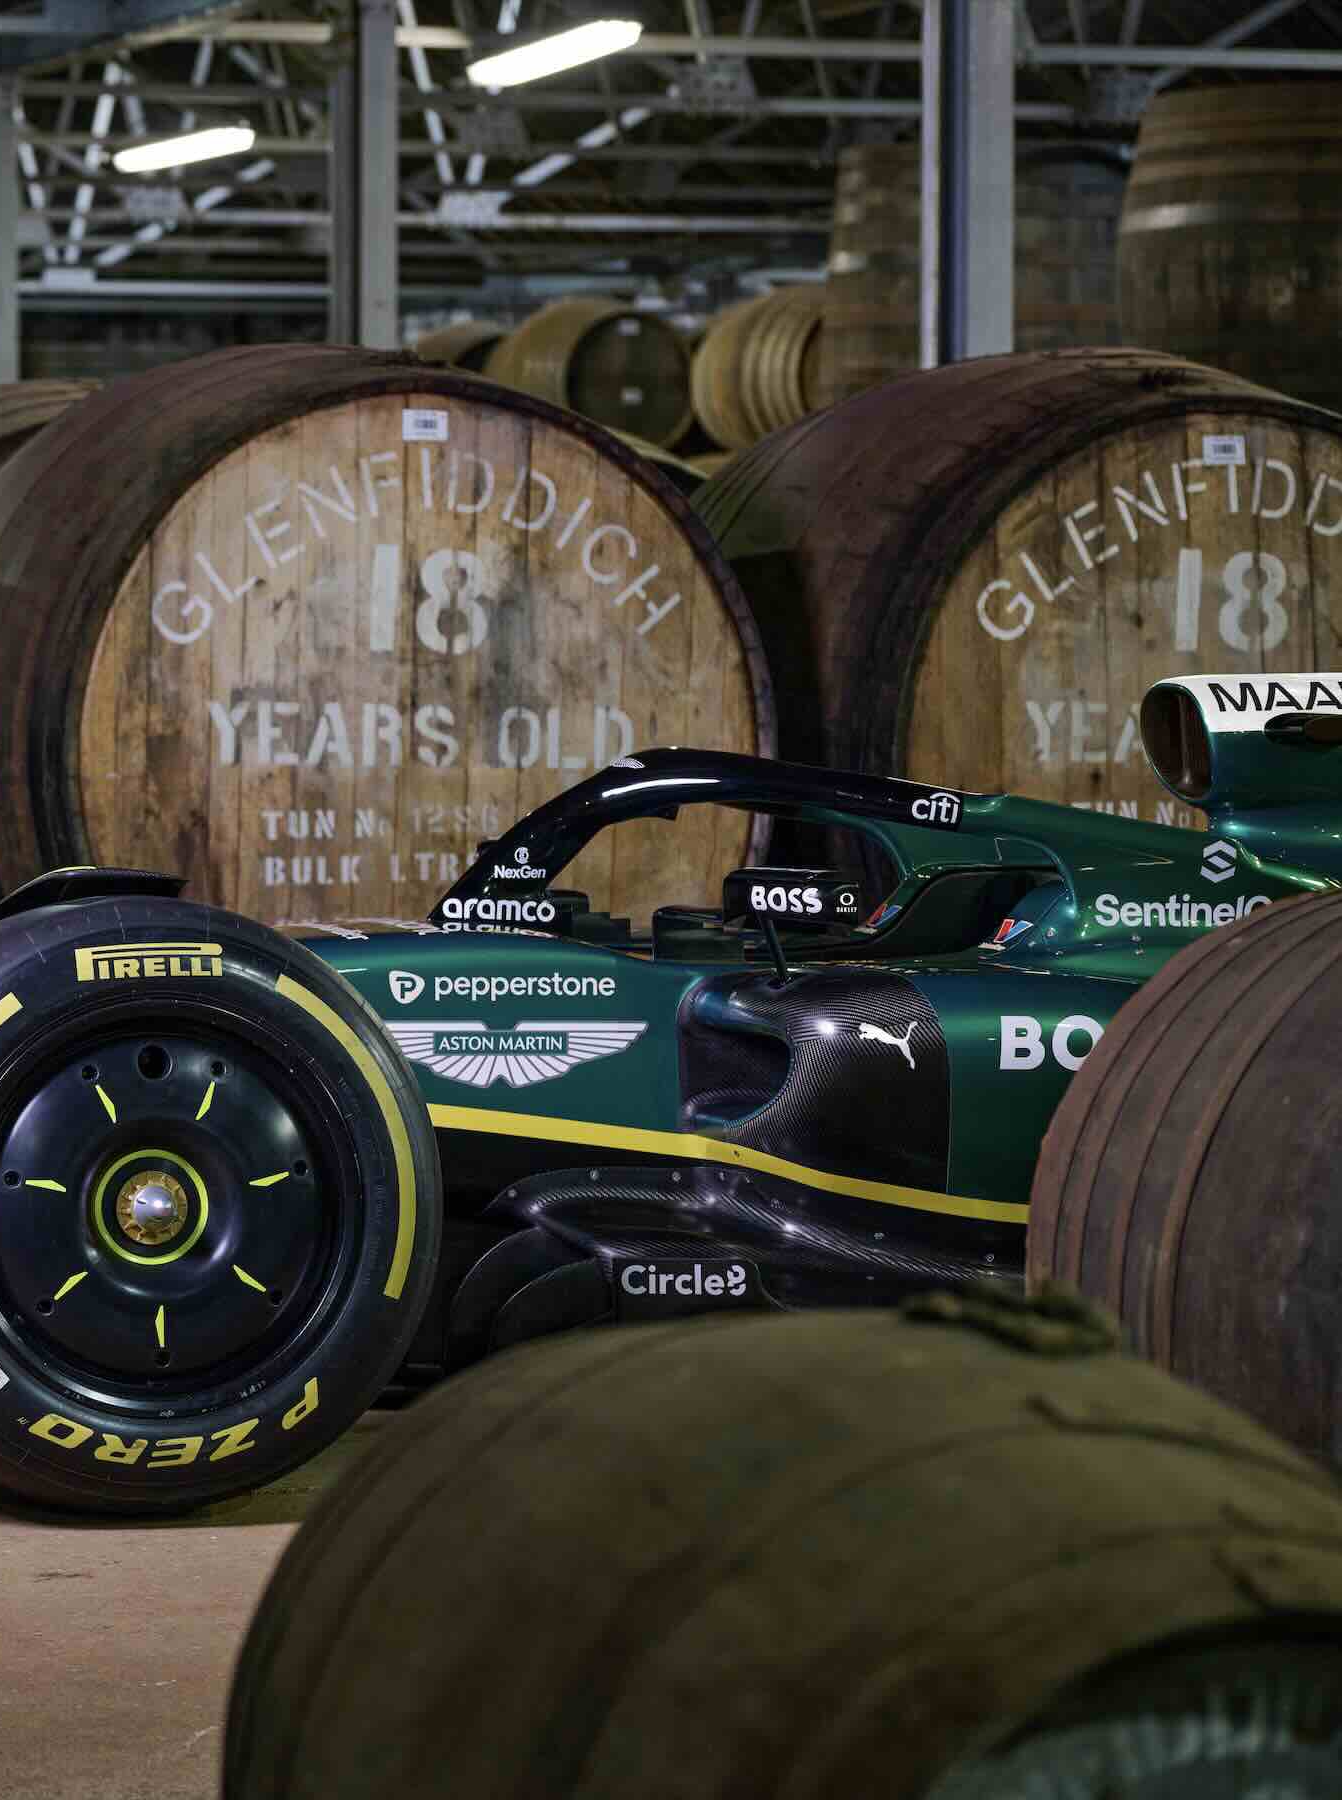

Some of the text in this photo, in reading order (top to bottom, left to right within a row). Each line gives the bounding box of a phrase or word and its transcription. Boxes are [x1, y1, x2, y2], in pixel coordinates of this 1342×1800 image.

[152, 446, 682, 645] GLENFIDDICH
[369, 542, 489, 656] 18
[1174, 547, 1289, 653] 18
[209, 700, 634, 771] YEARS OLD
[260, 807, 337, 841] TUN
[911, 792, 960, 825] citi
[264, 854, 363, 886] BULK
[494, 864, 547, 880] NexGen
[442, 897, 556, 922] aramco
[751, 885, 823, 914] BOSS
[74, 942, 224, 982] PIRELLI
[434, 972, 616, 1001] pepperstone
[438, 1036, 563, 1051] ASTON MARTIN
[28, 1376, 319, 1470] P ZERO
